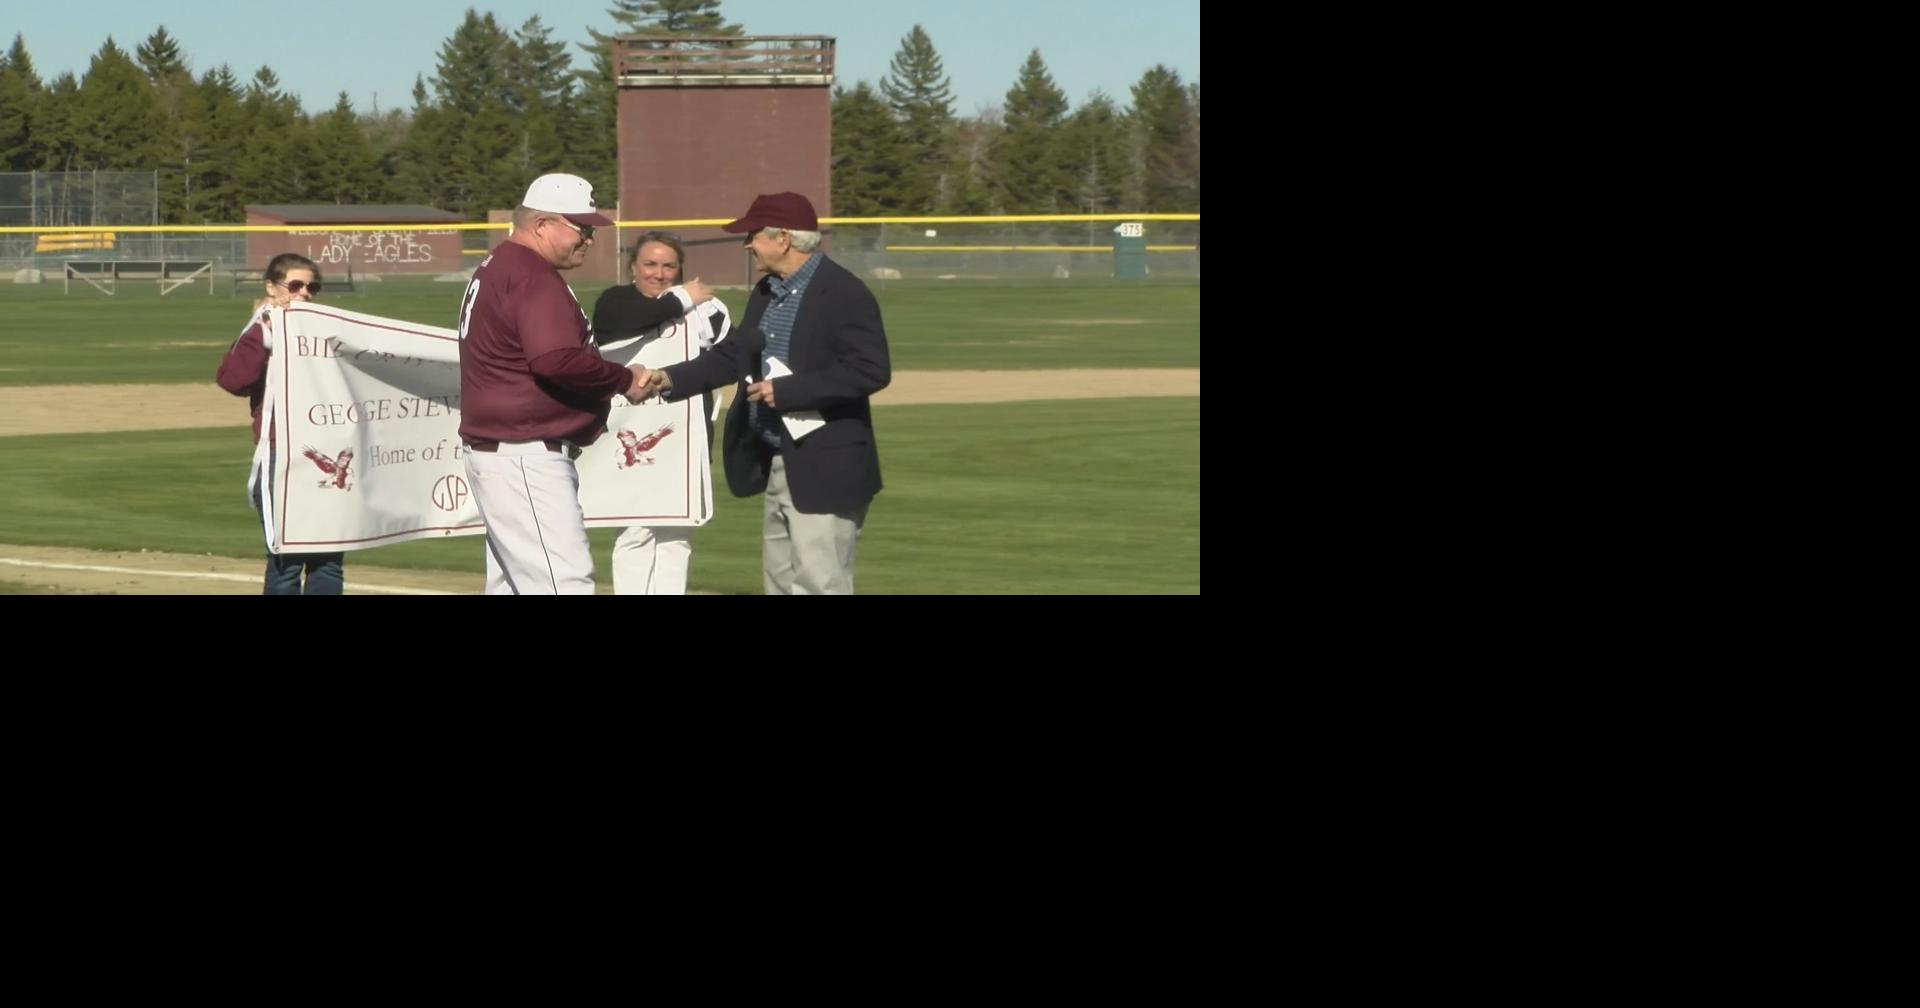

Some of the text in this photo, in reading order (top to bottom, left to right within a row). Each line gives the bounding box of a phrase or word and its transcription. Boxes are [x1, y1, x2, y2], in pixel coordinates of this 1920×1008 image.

[329, 232, 362, 247] HOME
[369, 233, 386, 247] OF
[390, 233, 416, 246] THE
[308, 243, 432, 263] LADY EAGLES
[370, 445, 415, 468] Home
[422, 439, 447, 461] of
